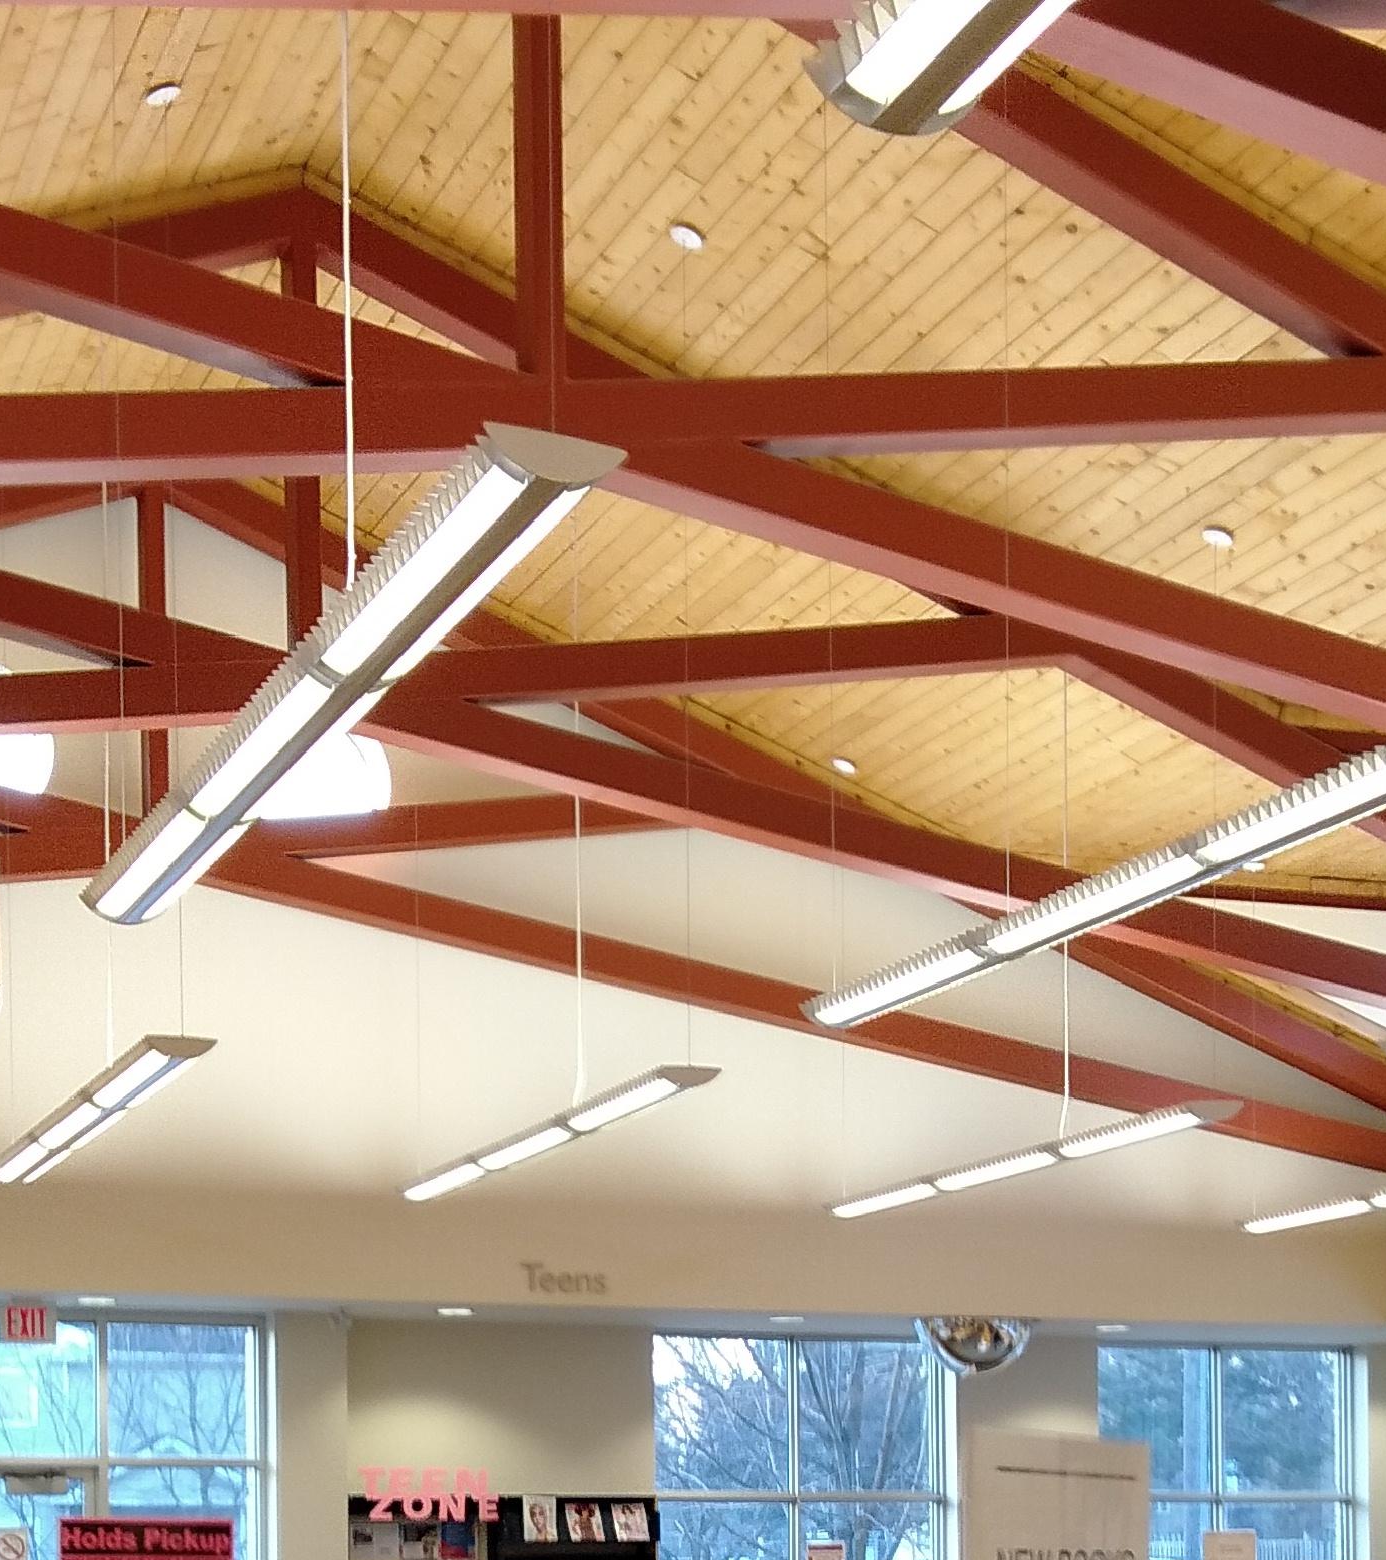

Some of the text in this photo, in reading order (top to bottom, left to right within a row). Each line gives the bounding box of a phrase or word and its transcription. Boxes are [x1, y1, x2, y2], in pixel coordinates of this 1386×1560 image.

[519, 1262, 607, 1295] Teens
[6, 1306, 46, 1338] EXIT
[357, 1466, 489, 1499] TEEN
[368, 1494, 500, 1522] ZONE
[62, 1527, 230, 1554] Holds Pickup
